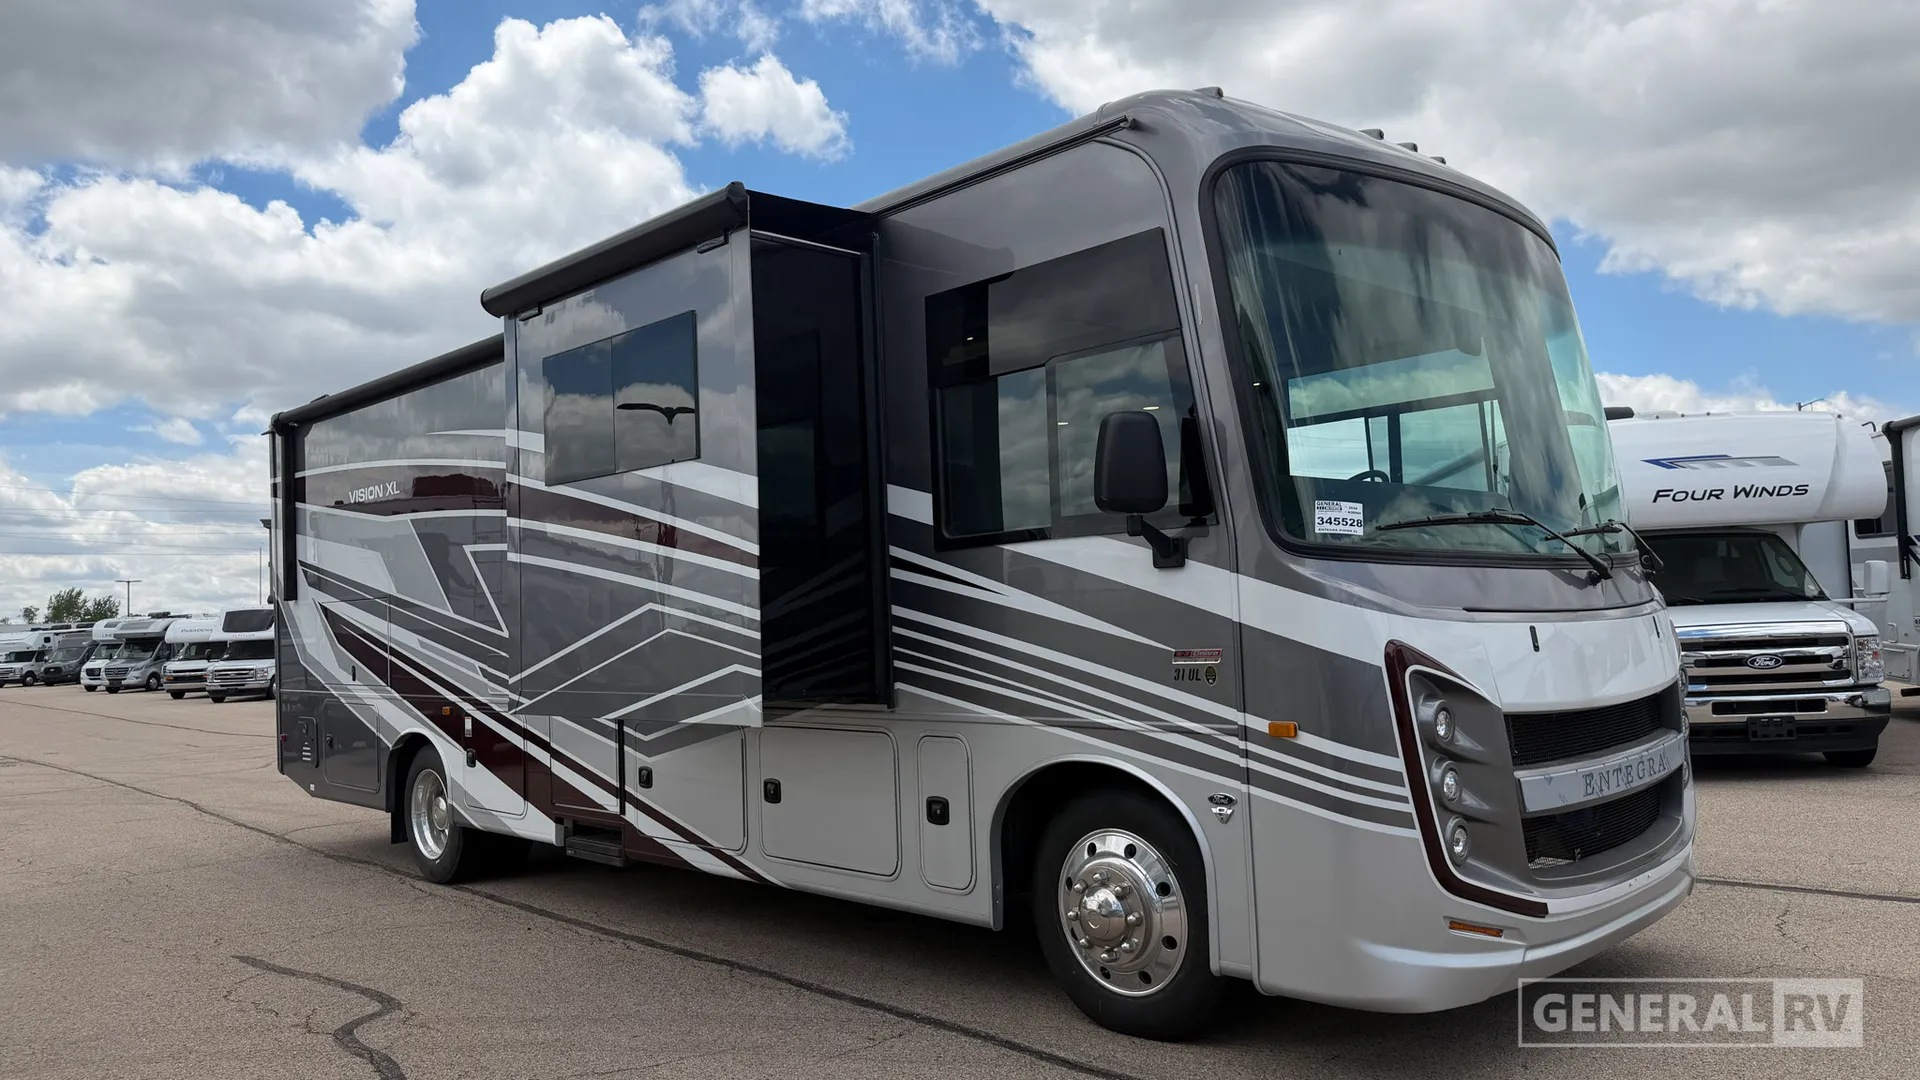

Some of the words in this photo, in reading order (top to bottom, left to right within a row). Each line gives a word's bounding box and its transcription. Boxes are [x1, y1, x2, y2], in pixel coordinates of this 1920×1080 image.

[349, 484, 383, 503] VISION
[386, 481, 400, 496] XL
[1652, 488, 1725, 503] FOUR
[1733, 484, 1809, 499] WINDS
[1317, 516, 1363, 527] 345528
[1750, 655, 1776, 666] Ford
[1173, 667, 1185, 682] 31
[1188, 667, 1202, 682] UL
[1582, 752, 1667, 797] ENTEGRA
[1212, 794, 1229, 804] Ford
